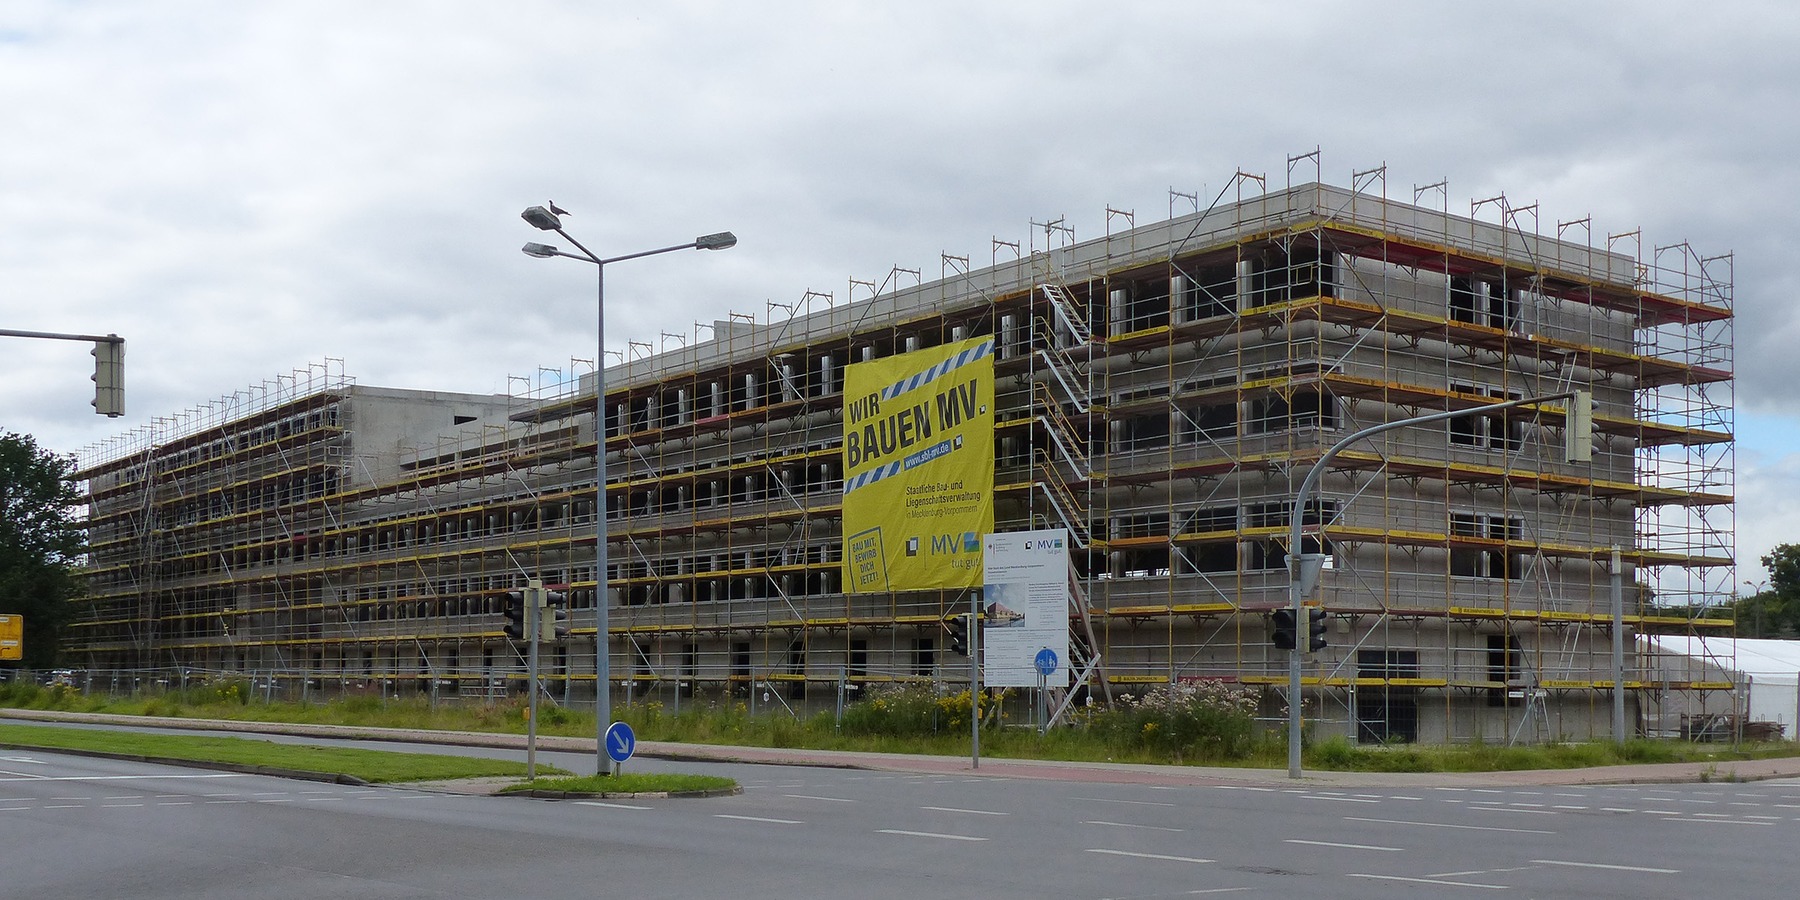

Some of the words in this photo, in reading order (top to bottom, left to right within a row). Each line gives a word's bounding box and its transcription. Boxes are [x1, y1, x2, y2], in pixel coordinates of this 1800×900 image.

[849, 392, 880, 425] WIR
[847, 401, 932, 470] BAUEN
[906, 484, 936, 496] Staatliche
[951, 479, 963, 491] und
[931, 532, 962, 556] MV
[1037, 539, 1054, 550] MV
[860, 571, 879, 586] JETZT!
